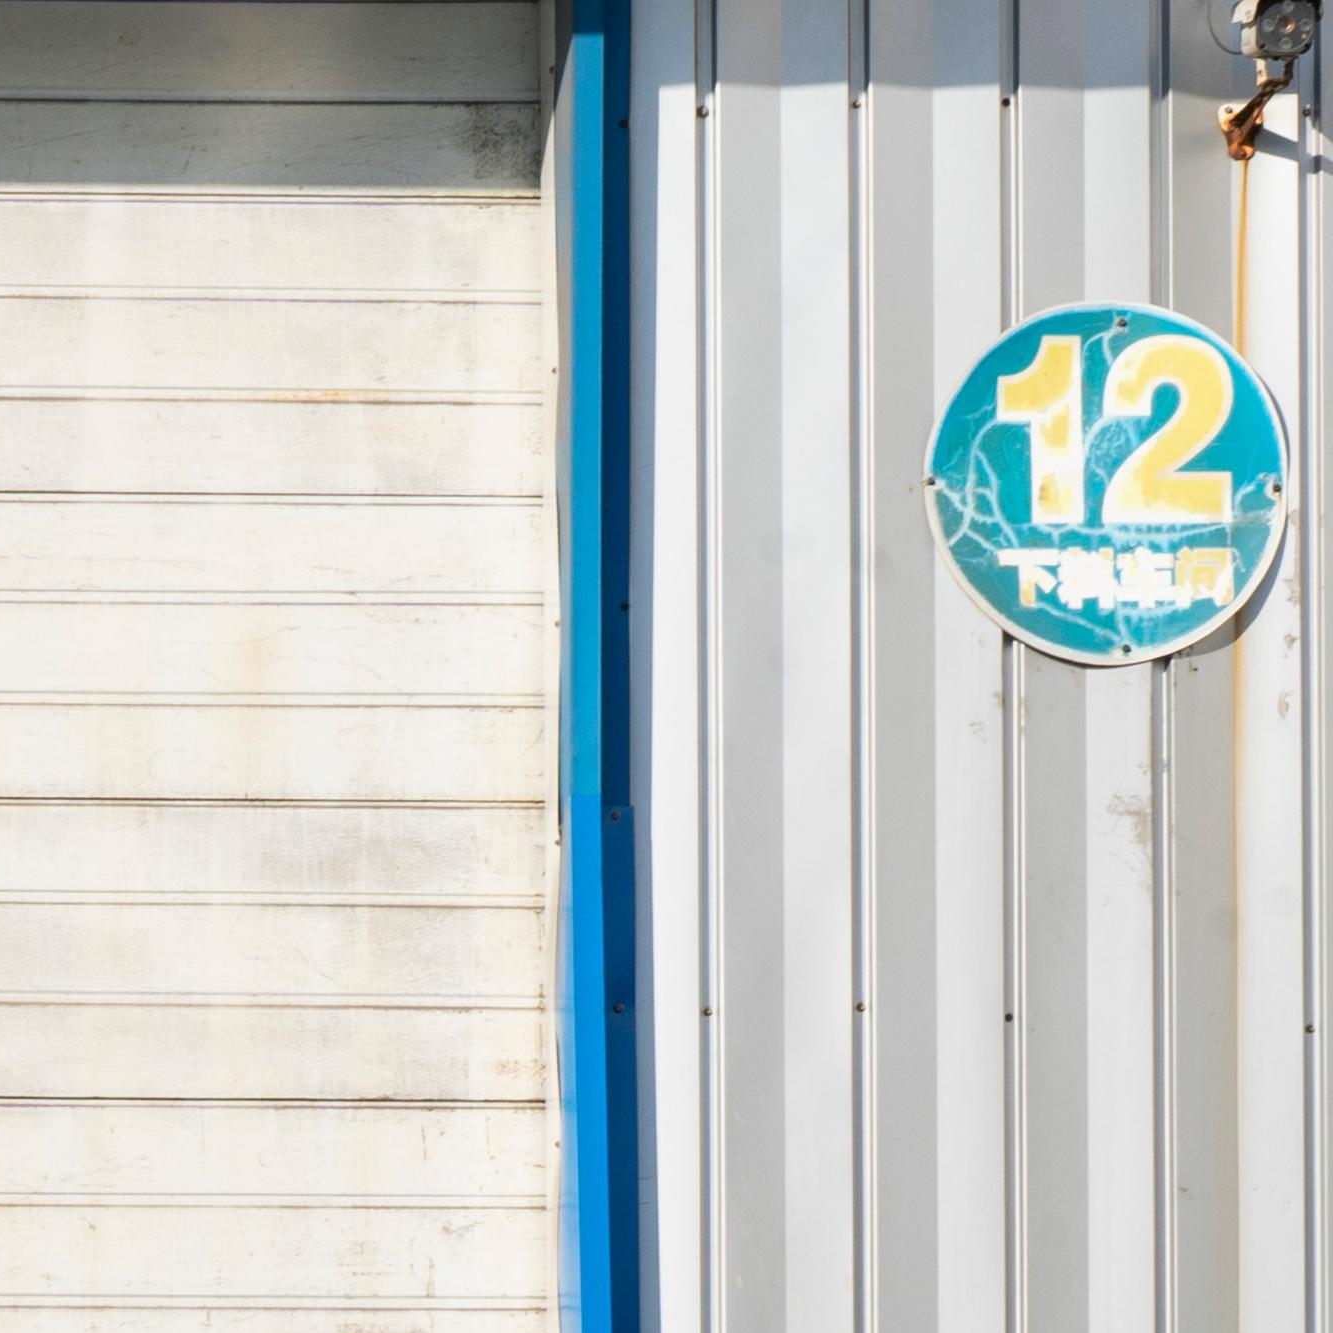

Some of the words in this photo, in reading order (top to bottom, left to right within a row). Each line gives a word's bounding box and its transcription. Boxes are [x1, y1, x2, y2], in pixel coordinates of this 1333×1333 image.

[997, 335, 1235, 526] 12
[996, 547, 1235, 609] 下料车间
